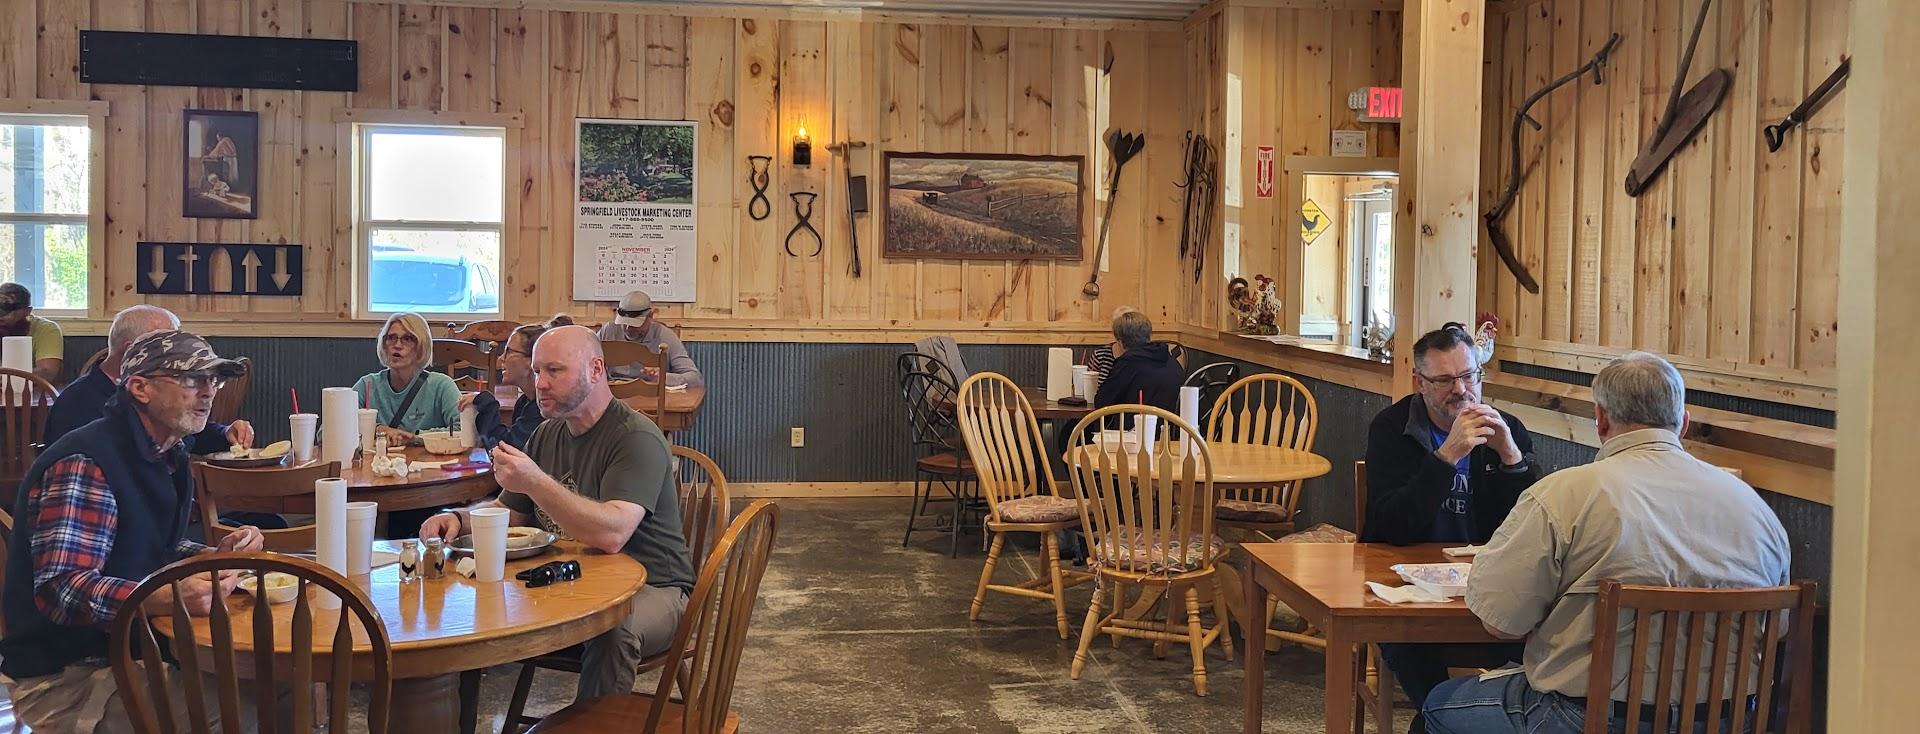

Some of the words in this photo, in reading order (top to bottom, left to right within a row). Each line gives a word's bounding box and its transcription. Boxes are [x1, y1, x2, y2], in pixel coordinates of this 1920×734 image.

[580, 206, 613, 216] SPRINGFIELD
[614, 207, 641, 217] LIVESTOCK
[642, 208, 671, 218] MARKETING
[672, 208, 692, 218] CENTER
